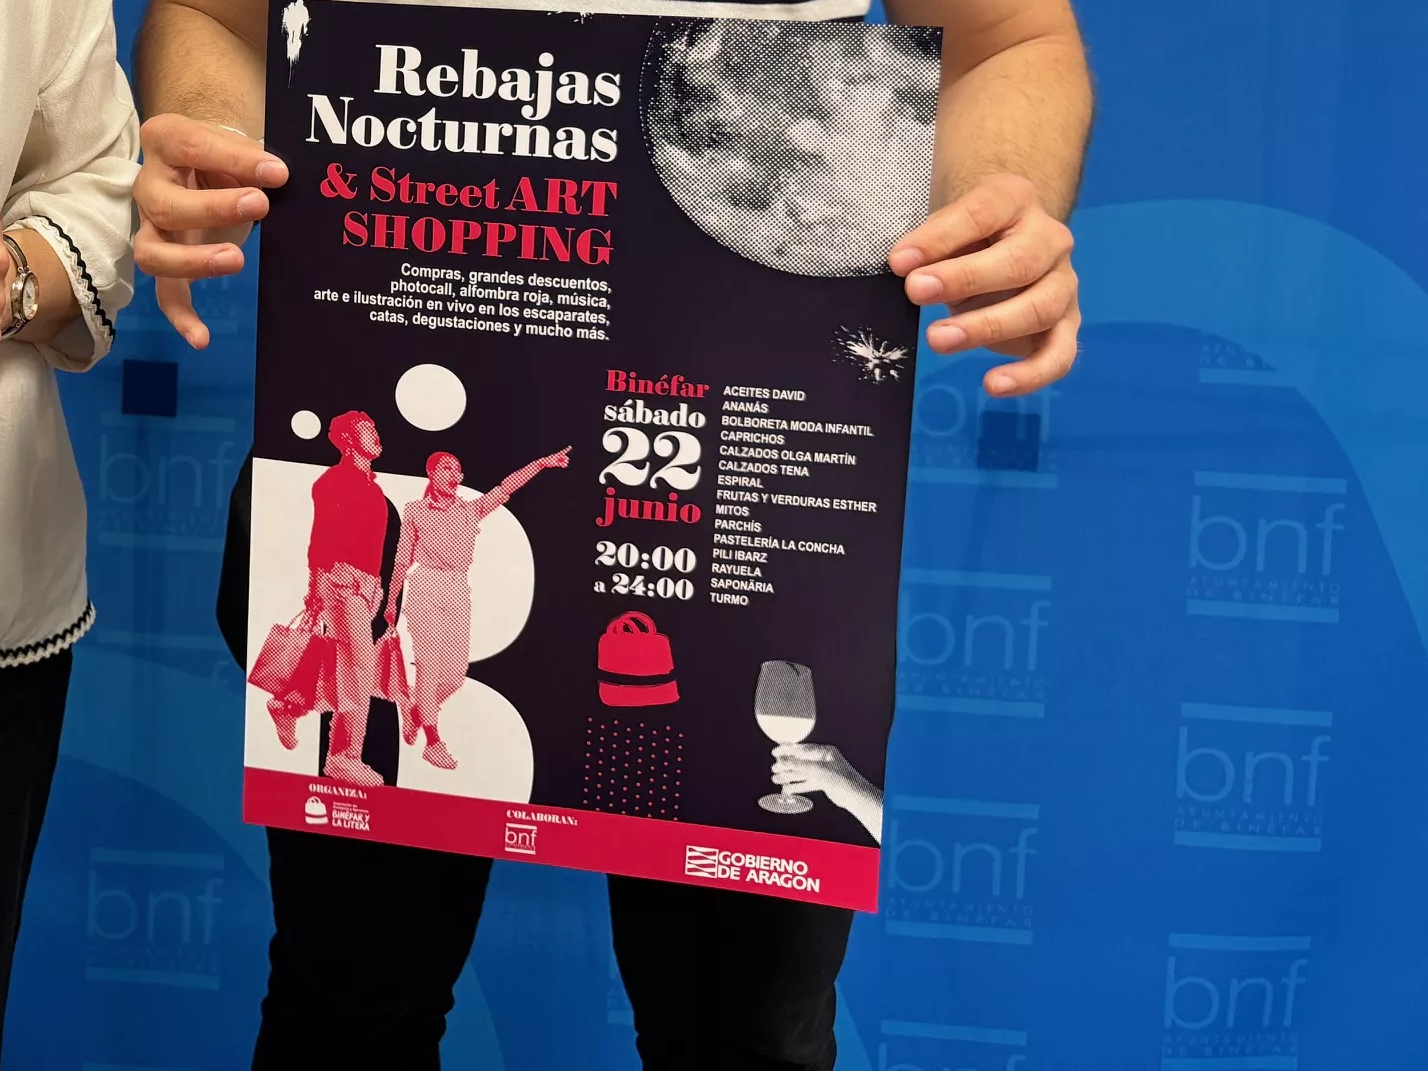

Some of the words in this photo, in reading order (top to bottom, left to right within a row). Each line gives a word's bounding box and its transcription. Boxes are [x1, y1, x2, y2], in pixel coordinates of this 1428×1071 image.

[374, 45, 620, 120] Rebajas
[306, 94, 617, 162] Nocturnas
[320, 163, 357, 199] &
[343, 211, 613, 265] SHOPPING
[401, 263, 464, 282] Compras,
[469, 271, 524, 285] grandes
[528, 273, 611, 293] descuentos,
[314, 289, 338, 301] arte
[342, 293, 350, 302] e
[354, 291, 422, 308] ilustración
[427, 300, 442, 310] en
[447, 300, 475, 313] vivo
[479, 305, 495, 315] en
[499, 303, 519, 317] los
[523, 304, 610, 326] escaparates,
[391, 279, 455, 298] photocall,
[460, 284, 519, 301] alfombra
[524, 290, 553, 305] roja,
[558, 292, 610, 310] música,
[370, 310, 408, 325] catas,
[413, 312, 510, 332] degustaciones
[514, 324, 522, 336] y
[526, 324, 573, 337] mucho
[577, 329, 609, 340] más.
[606, 370, 709, 398] Binéfar
[723, 386, 770, 398] ACEITES
[773, 389, 805, 401] DAVID
[604, 399, 706, 428] sábado
[722, 401, 769, 413] ANANÁS
[721, 431, 784, 444] CAPRICHOS
[722, 416, 788, 430] BOLBORETA
[790, 421, 823, 432] MODA
[825, 423, 874, 436] INFANTIL
[599, 427, 701, 490] 22
[719, 460, 777, 474] CALZADOS
[780, 465, 809, 476] TENA
[720, 445, 779, 459] CALZADOS
[781, 450, 812, 462] OLGA
[814, 453, 855, 465] MARTÍN
[99, 433, 234, 508] bnf
[718, 475, 763, 488] ESPIRAL
[596, 487, 701, 526] junio
[716, 504, 749, 516] MITOS
[717, 490, 759, 502] FRUTAS
[761, 493, 768, 503] Y
[771, 494, 830, 508] VERDURAS
[833, 499, 876, 512] ESTHER
[715, 519, 761, 532] PARCHÍS
[1188, 495, 1345, 576] bnf
[595, 541, 696, 572] 20:00
[713, 548, 732, 559] PILI
[735, 551, 767, 562] IBARZ
[714, 534, 779, 548] PASTELERÍA
[782, 540, 796, 550] LA
[798, 541, 845, 554] CONCHA
[712, 563, 761, 577] RAYUELA
[594, 582, 605, 592] a
[611, 573, 693, 600] 24:00
[710, 593, 748, 605] TURMO
[897, 590, 1050, 671] bnf
[1175, 725, 1331, 807] bnf
[309, 784, 366, 798] ORGANIZA:
[507, 810, 577, 825] COLABORAN:
[505, 826, 537, 846] bnf
[718, 865, 740, 880] DE
[719, 851, 808, 875] GOBIERNO
[888, 819, 1038, 899] bnf
[87, 869, 224, 944] bnf
[1164, 956, 1308, 1030] bnf
